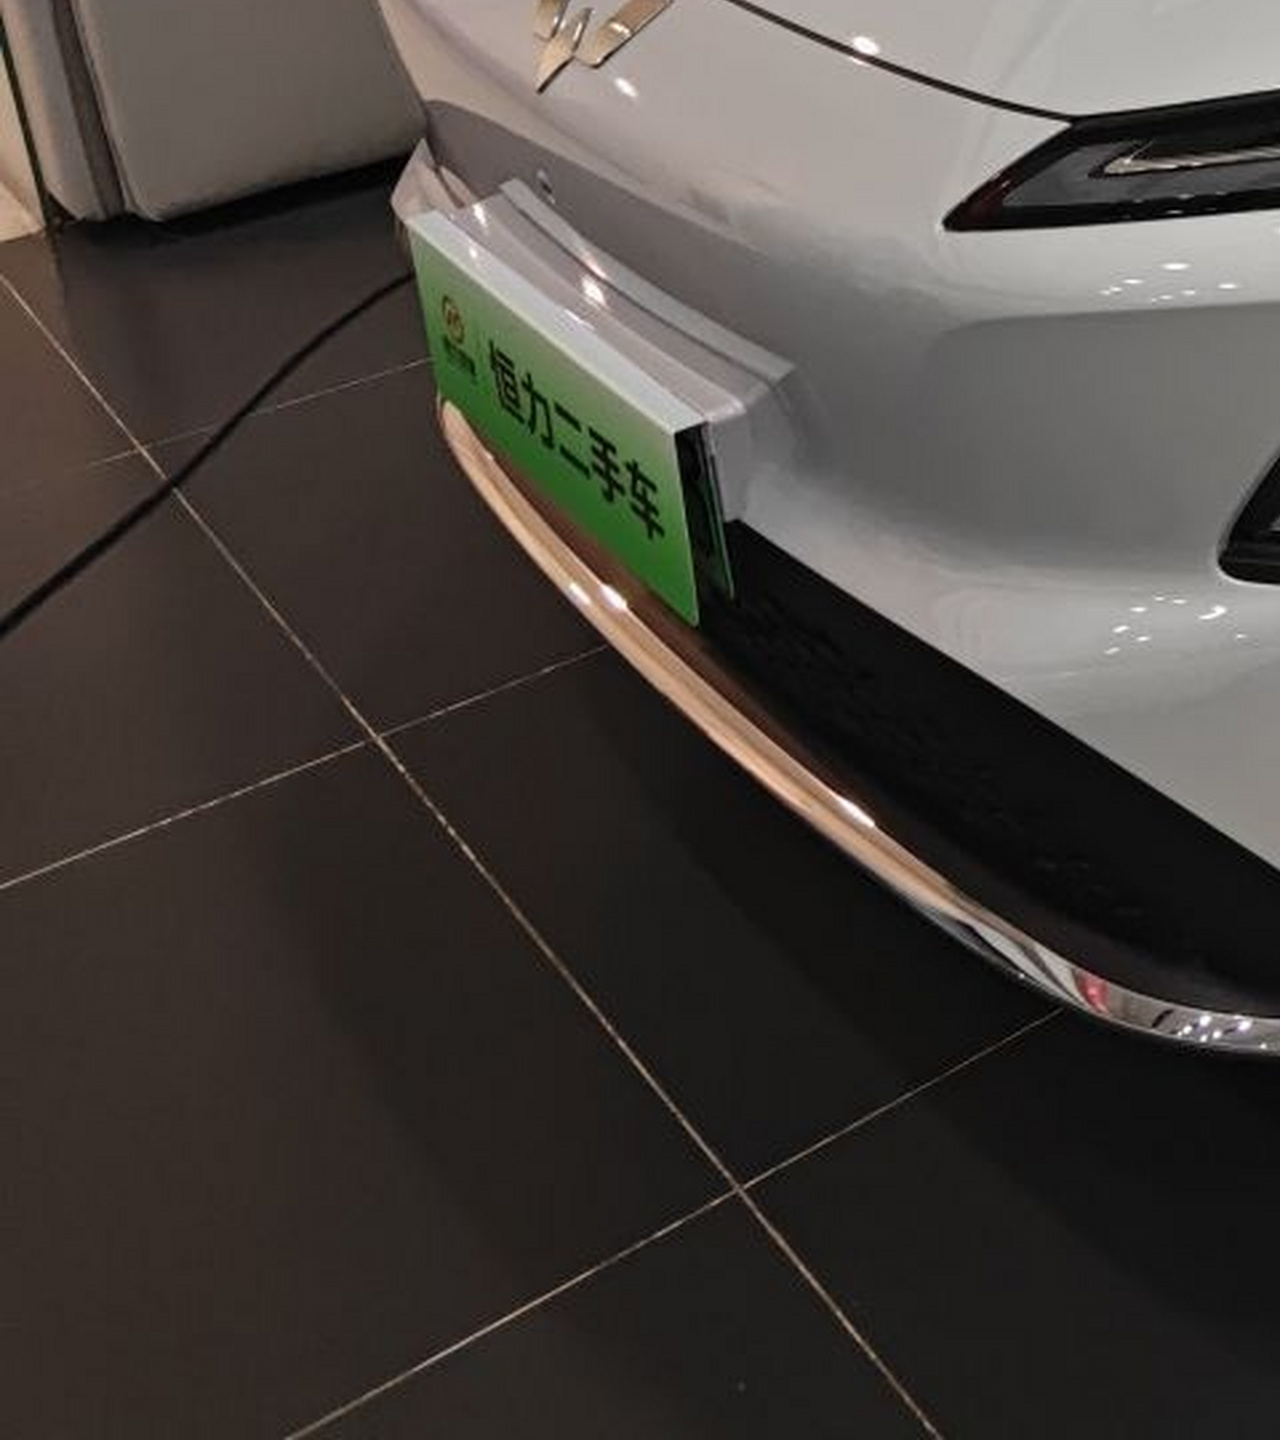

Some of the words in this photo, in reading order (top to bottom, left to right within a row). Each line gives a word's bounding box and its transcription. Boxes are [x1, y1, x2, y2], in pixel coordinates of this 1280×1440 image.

[487, 338, 665, 540] 恒力二手车
